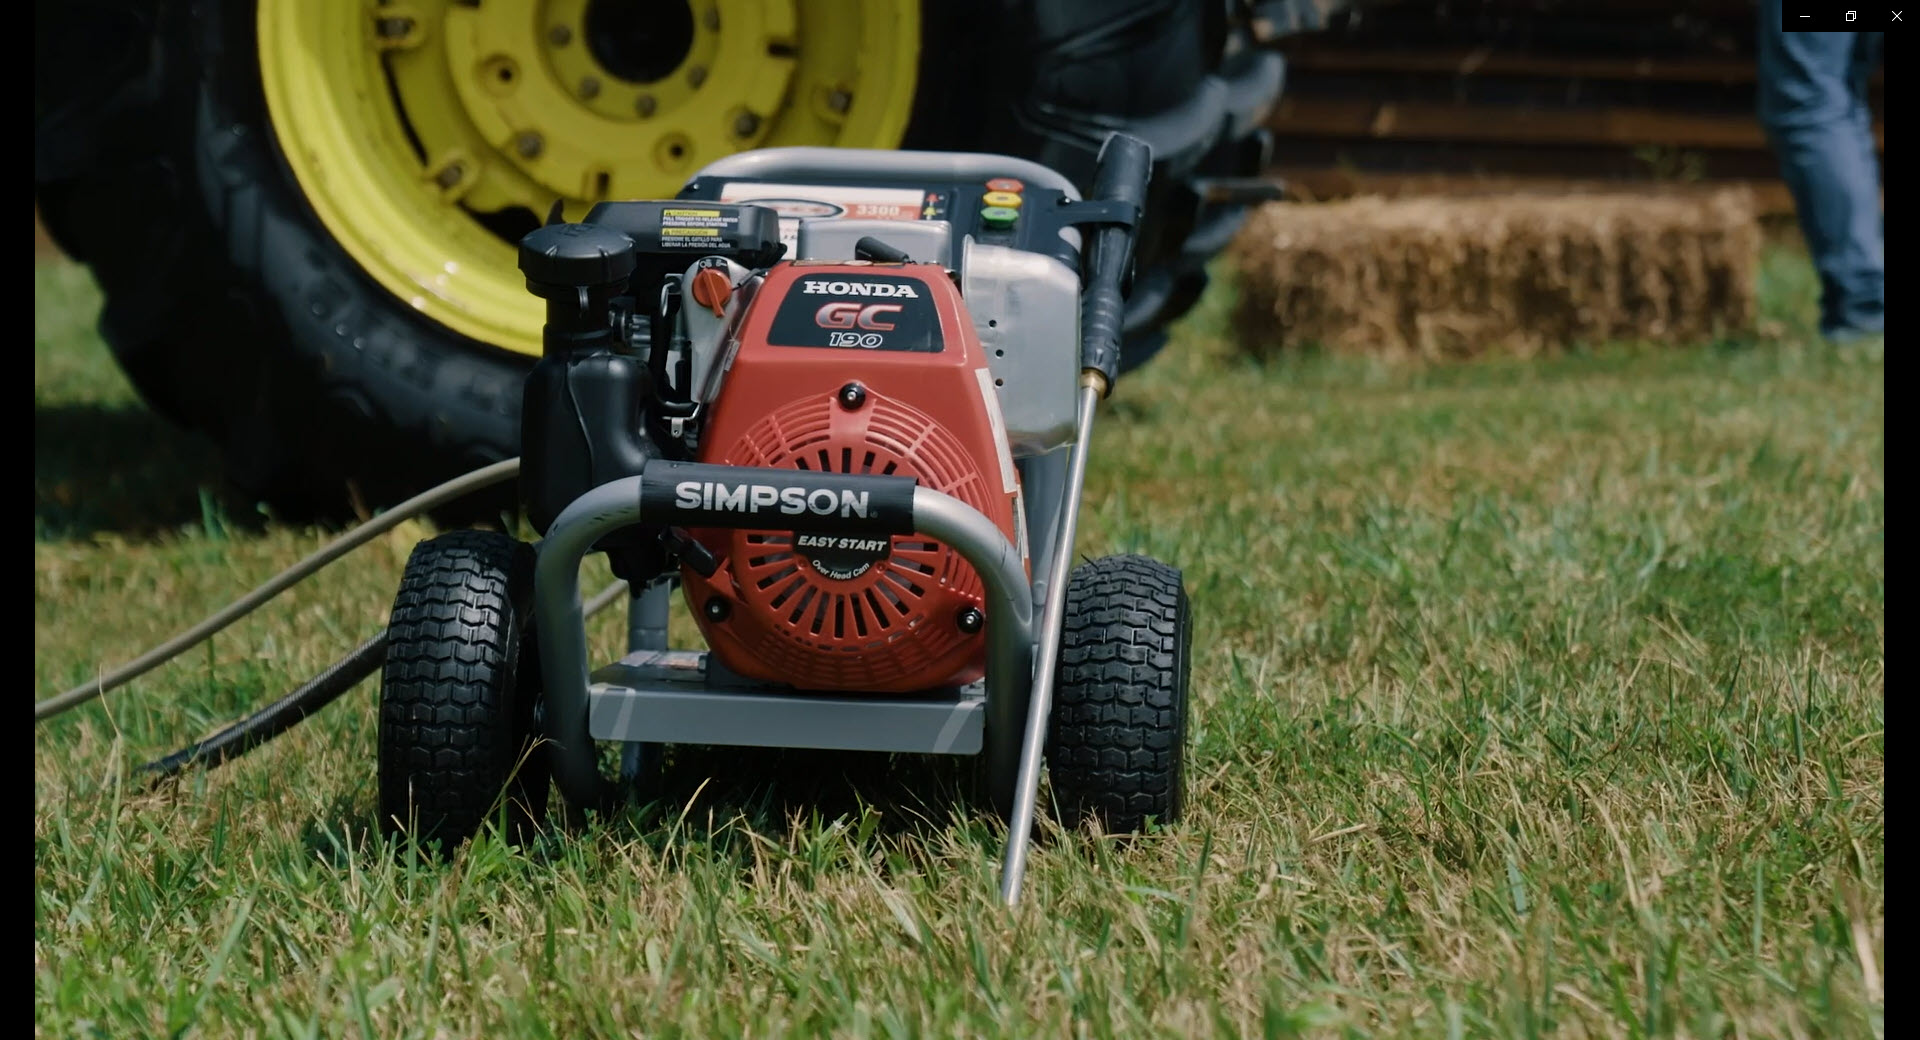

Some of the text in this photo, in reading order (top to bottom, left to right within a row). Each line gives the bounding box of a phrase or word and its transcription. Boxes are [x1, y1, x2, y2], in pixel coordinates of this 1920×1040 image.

[857, 205, 899, 215] 3300
[803, 281, 918, 298] HONDA
[815, 302, 903, 331] GC
[829, 332, 883, 348] 190
[675, 481, 869, 518] SIMPSON
[798, 535, 888, 552] EASY START
[812, 559, 870, 580] Over Head Cam
